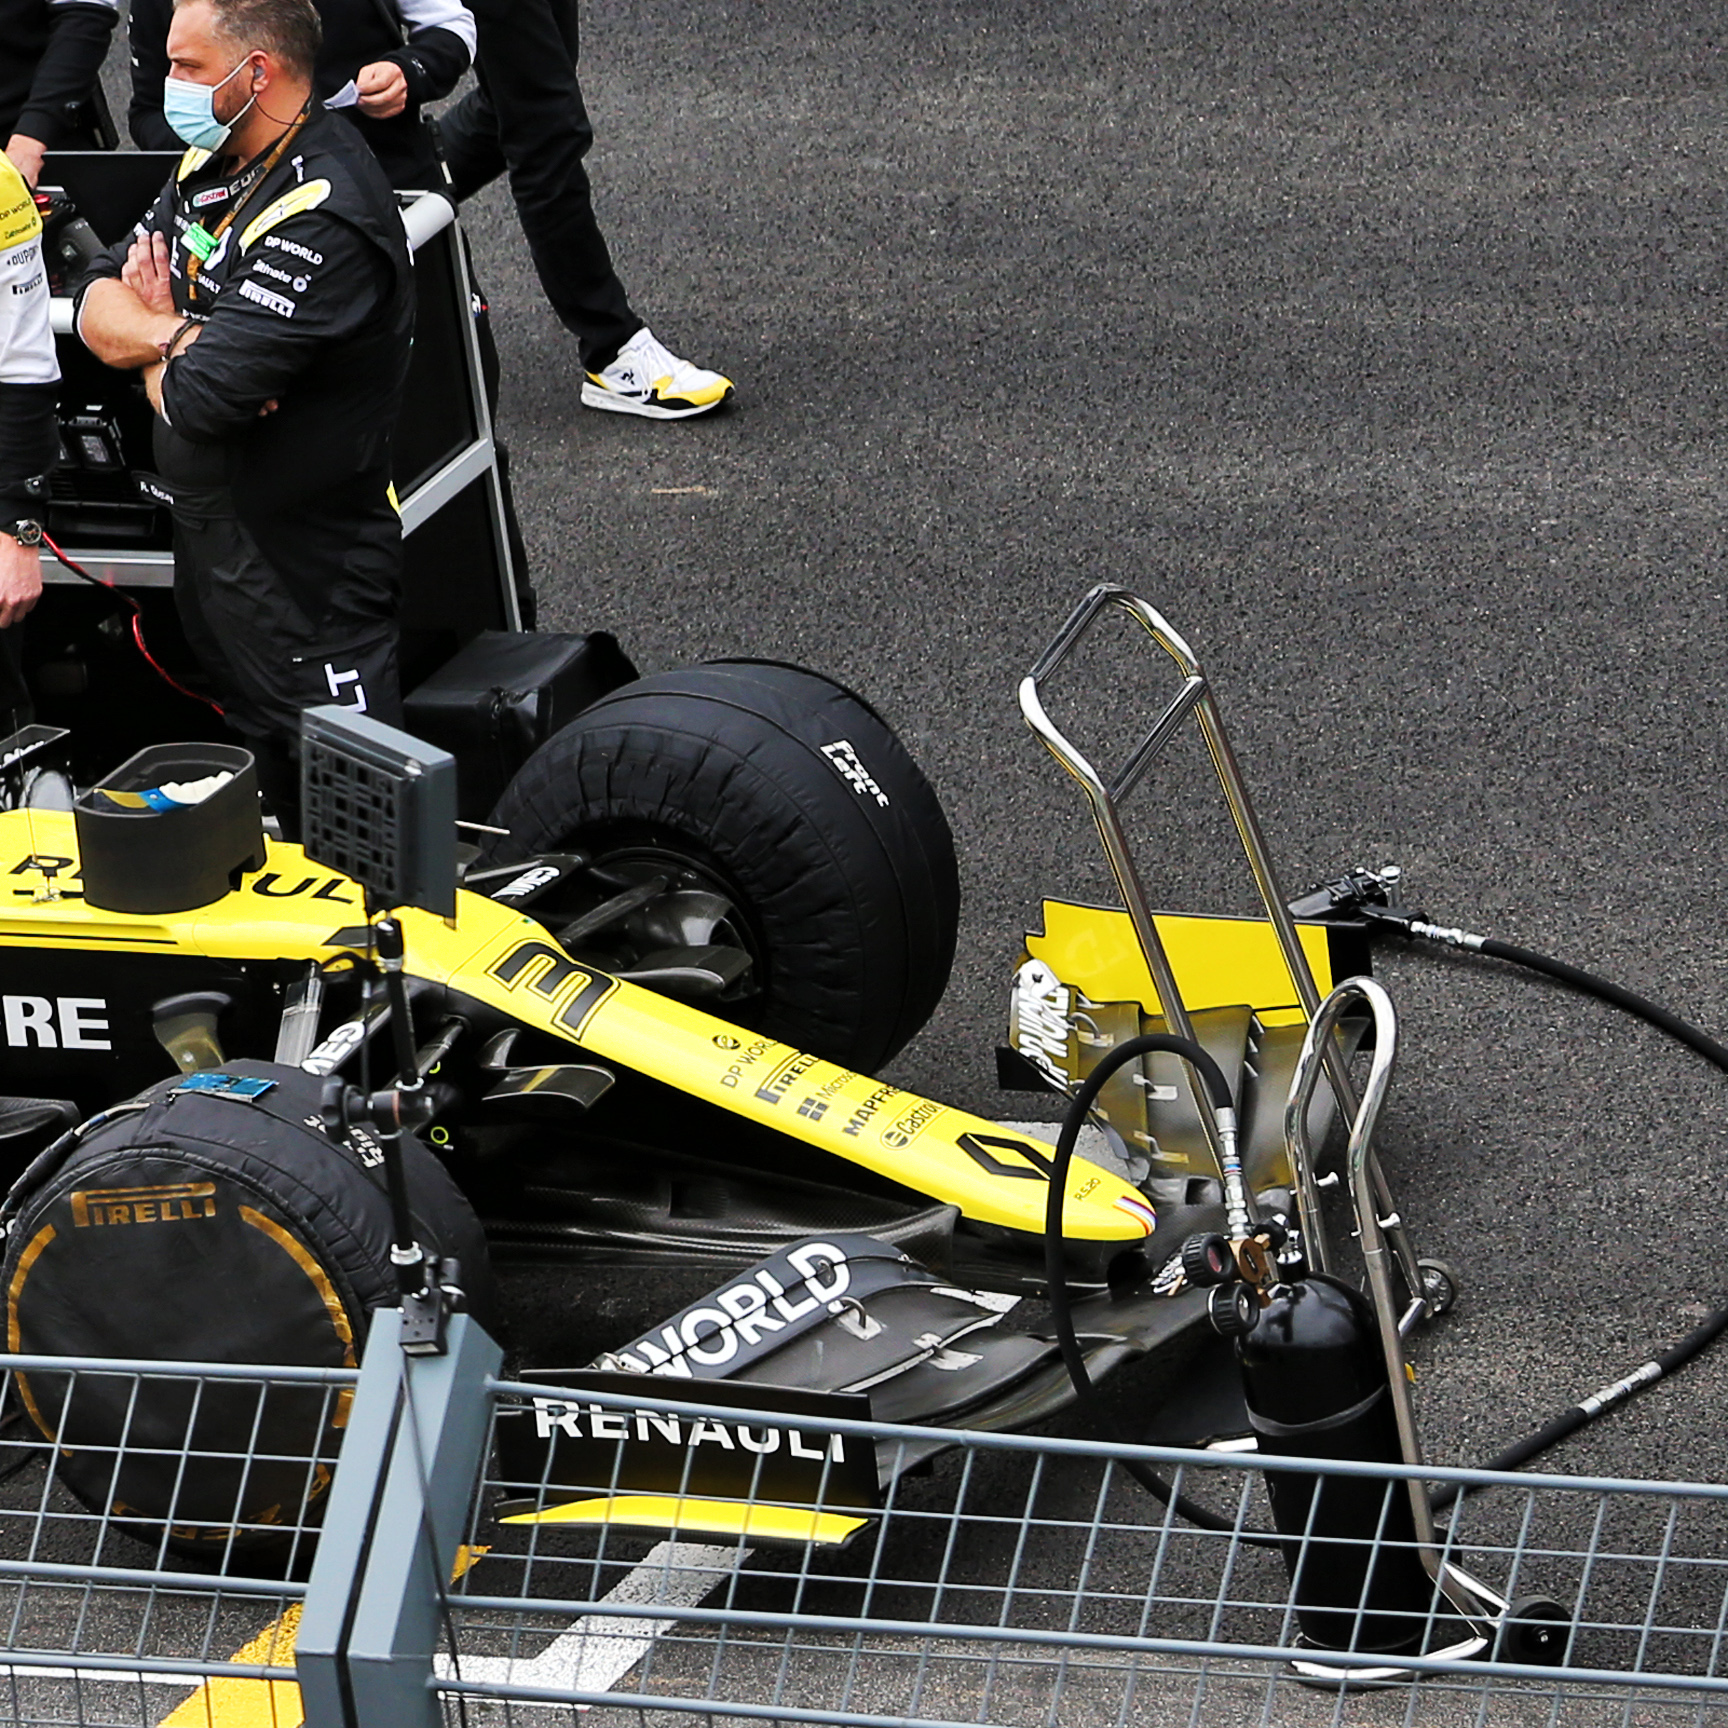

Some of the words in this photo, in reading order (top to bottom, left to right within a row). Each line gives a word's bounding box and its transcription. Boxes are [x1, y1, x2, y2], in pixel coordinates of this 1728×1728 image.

[264, 235, 282, 252] DP
[281, 240, 324, 269] WORLD
[239, 279, 297, 319] PIRELLI
[819, 743, 870, 798] Left
[834, 739, 890, 809] Front
[484, 936, 624, 1042] 3
[720, 1062, 745, 1089] DP
[69, 1181, 217, 1229] PIRELLI
[620, 1240, 852, 1379] WORLD
